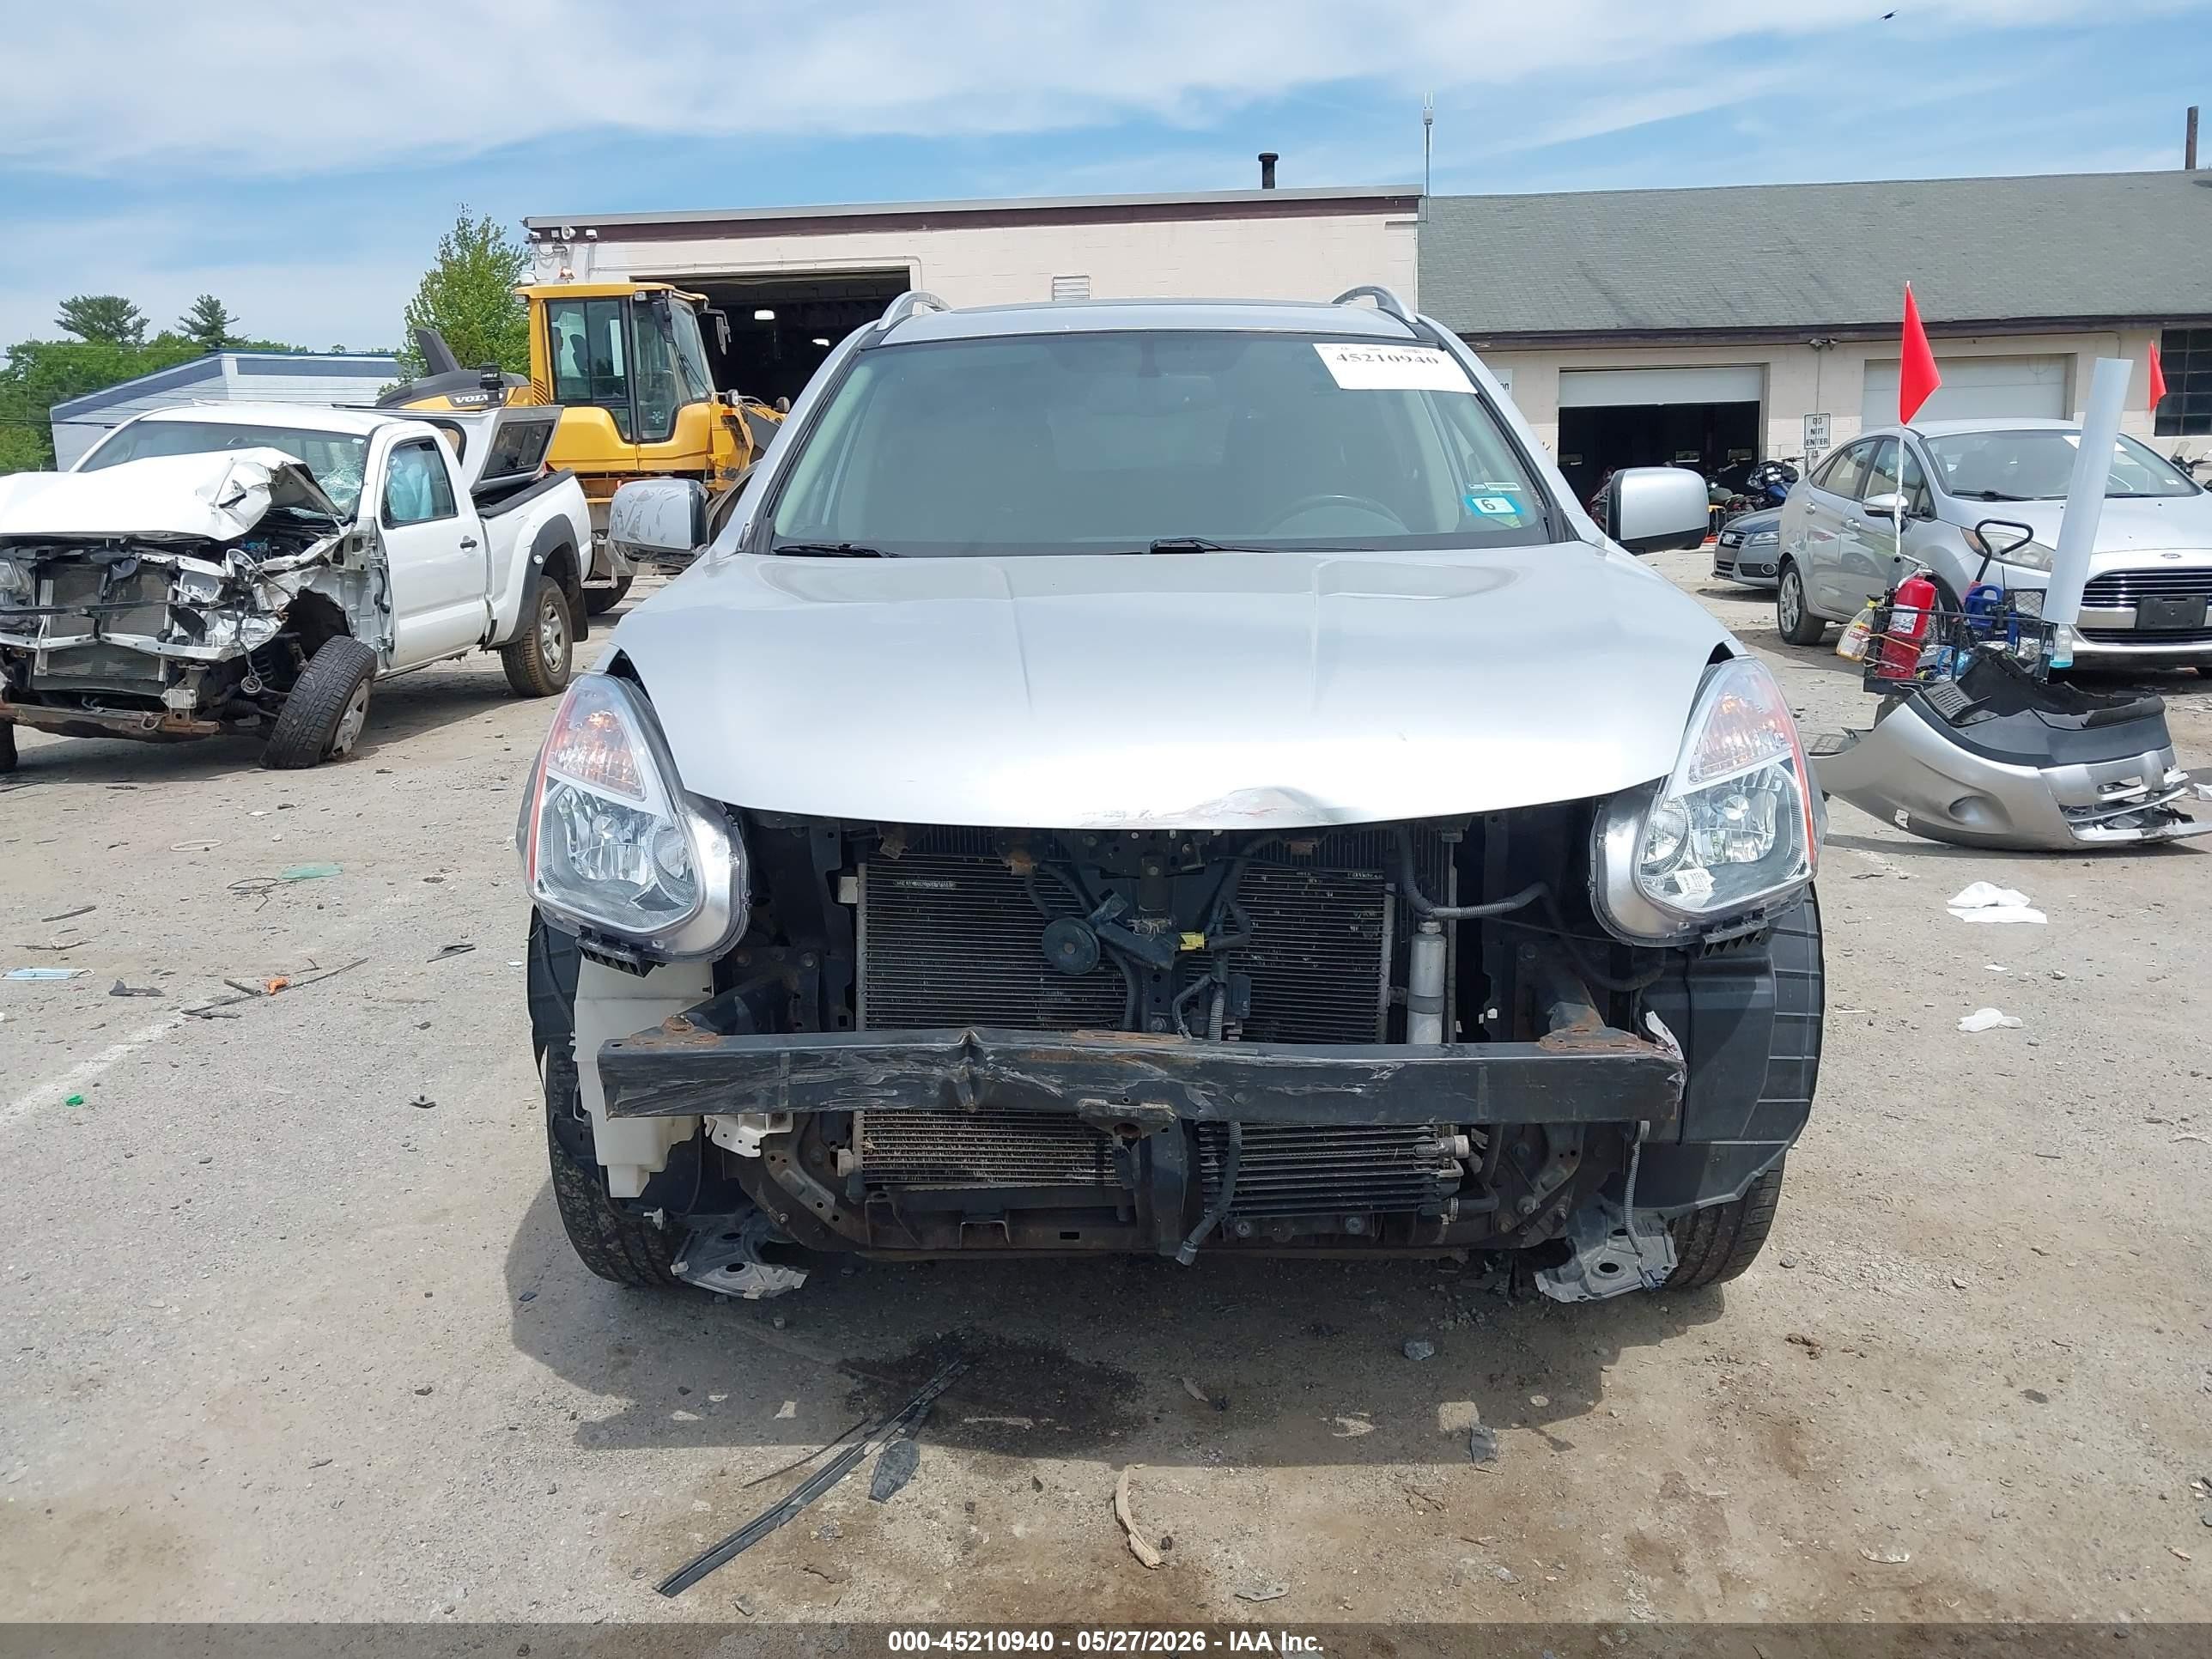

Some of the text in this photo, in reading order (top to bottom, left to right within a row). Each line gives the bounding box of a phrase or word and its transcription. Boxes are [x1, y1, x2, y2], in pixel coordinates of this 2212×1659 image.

[1336, 353, 1439, 364] 45210940
[1806, 437, 1828, 447] ENTER
[1480, 499, 1497, 511] 6
